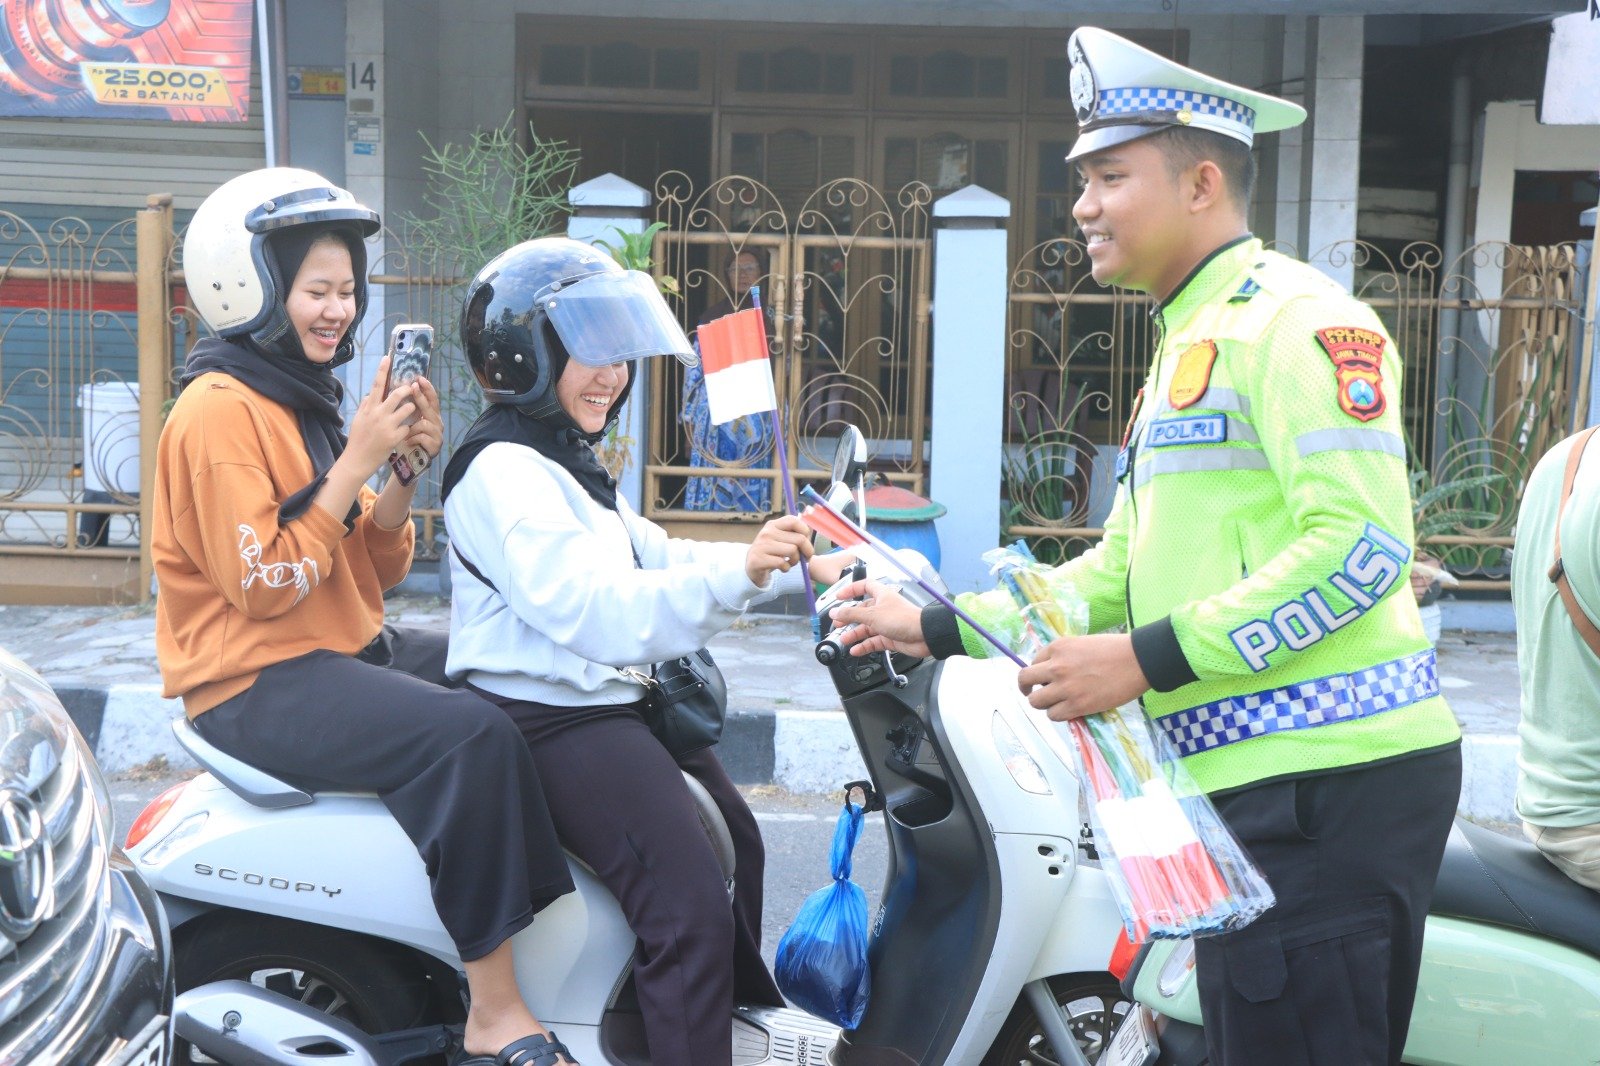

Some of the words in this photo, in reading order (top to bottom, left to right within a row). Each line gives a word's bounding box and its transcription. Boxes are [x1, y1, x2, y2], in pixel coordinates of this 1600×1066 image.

[104, 68, 220, 93] 25.000,-
[351, 61, 376, 92] 14
[104, 84, 129, 99] /12
[137, 85, 206, 101] BATANG
[1324, 329, 1382, 346] POLRES
[1152, 421, 1215, 442] POLRI
[1227, 520, 1412, 673] POLISI
[194, 863, 342, 898] SCOOPY
[797, 1034, 809, 1066] SCOOP
